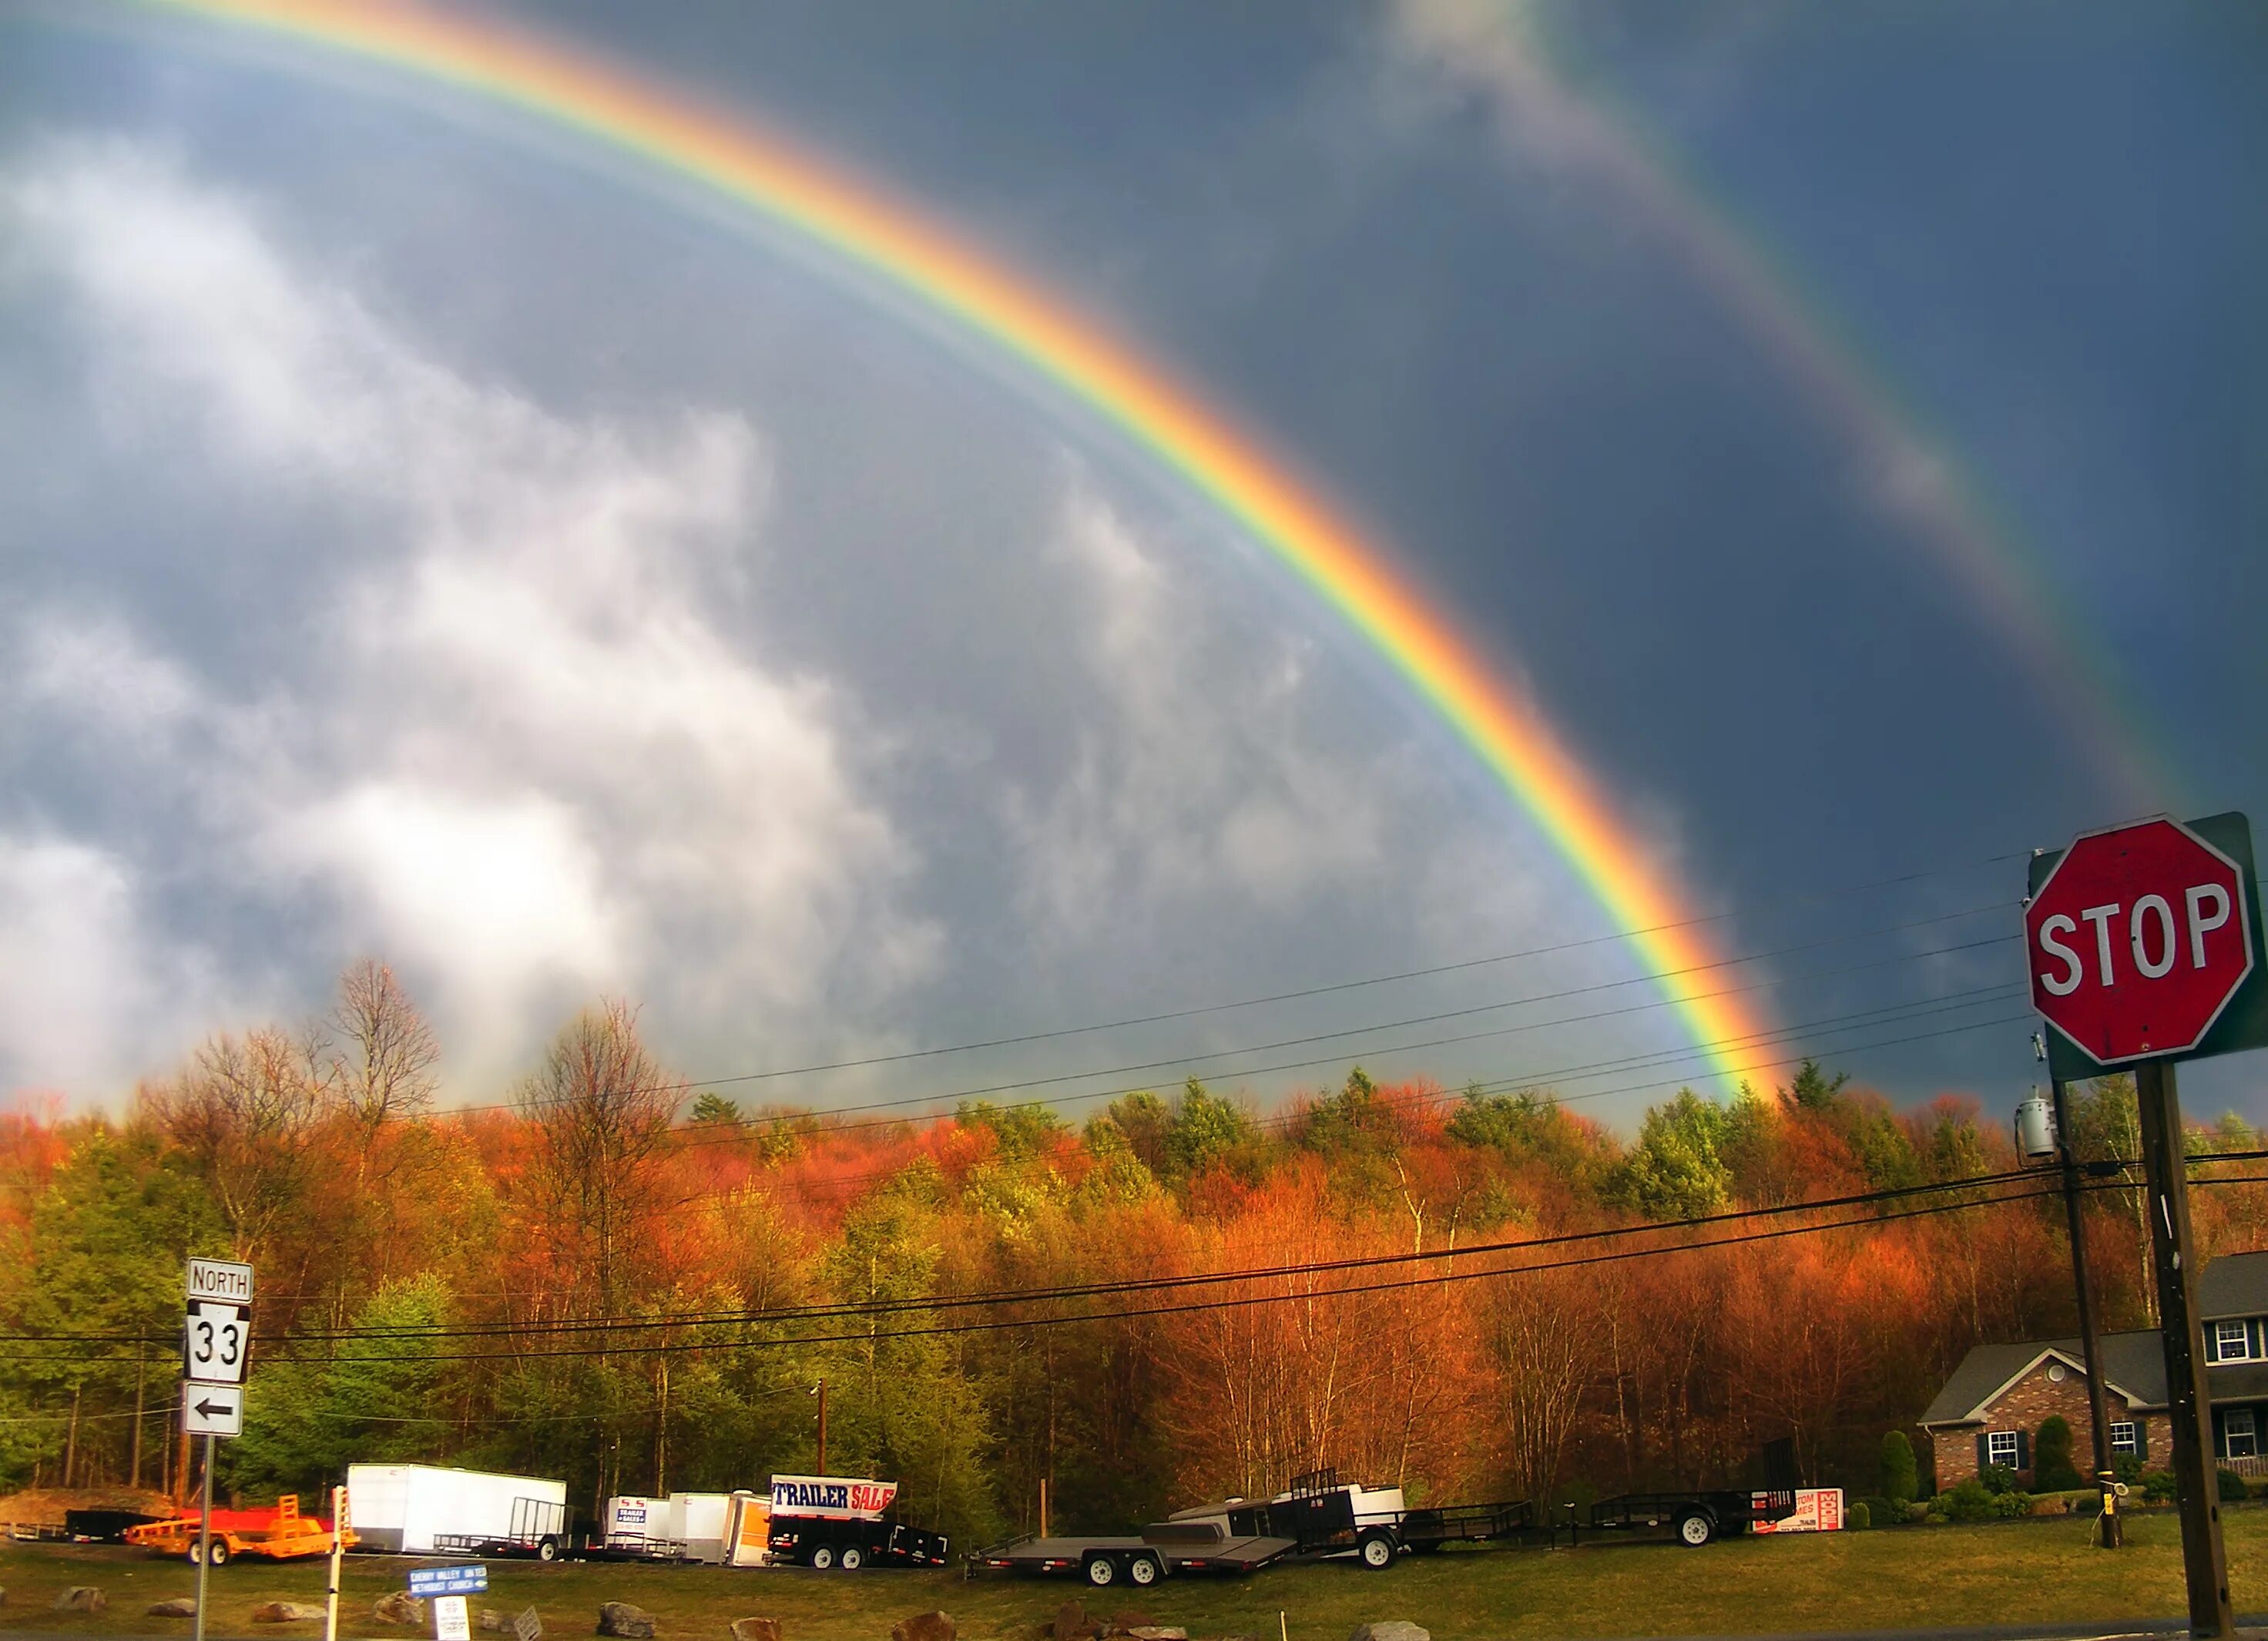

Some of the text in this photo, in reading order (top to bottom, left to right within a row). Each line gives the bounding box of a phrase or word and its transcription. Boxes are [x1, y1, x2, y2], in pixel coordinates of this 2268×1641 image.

[2039, 883, 2231, 996] STOP
[193, 1265, 247, 1295] NORTH
[195, 1321, 239, 1366] 33
[773, 1482, 848, 1509] TRAILER
[1796, 1494, 1814, 1505] TOM
